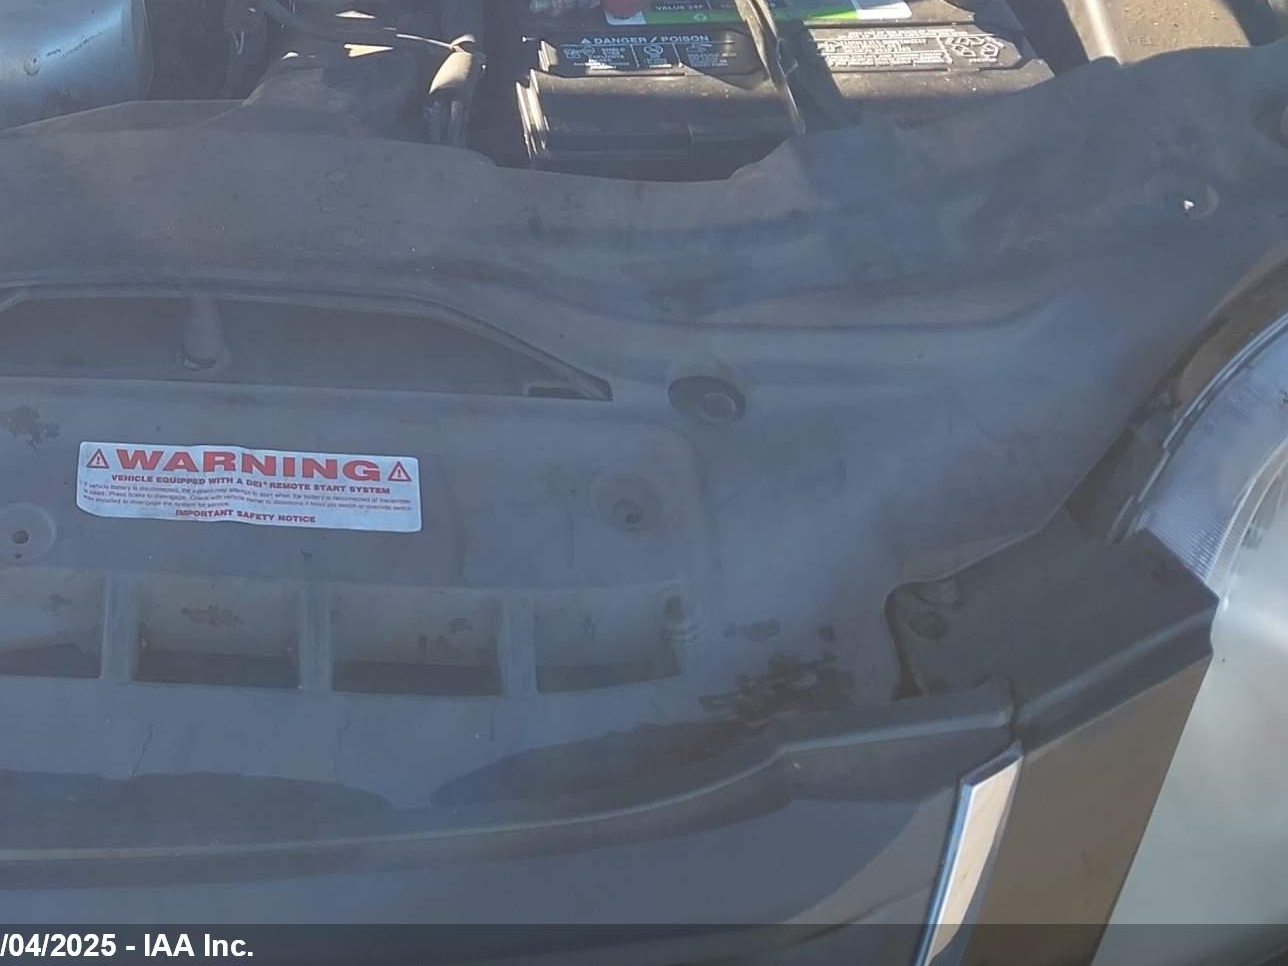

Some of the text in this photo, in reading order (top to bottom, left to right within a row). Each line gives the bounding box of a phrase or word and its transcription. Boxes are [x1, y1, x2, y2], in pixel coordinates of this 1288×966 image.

[593, 36, 646, 44] DANGER
[661, 35, 710, 43] POISON
[116, 449, 381, 482] WARNING
[111, 474, 153, 483] VEHICLE
[156, 476, 206, 485] EQUIPPED
[208, 477, 233, 485] WITH
[269, 481, 311, 491] REMOTE
[313, 484, 347, 493] START
[349, 486, 391, 495] SYSTEM
[175, 509, 316, 523] IMPORTANT SAFETY NOTICE
